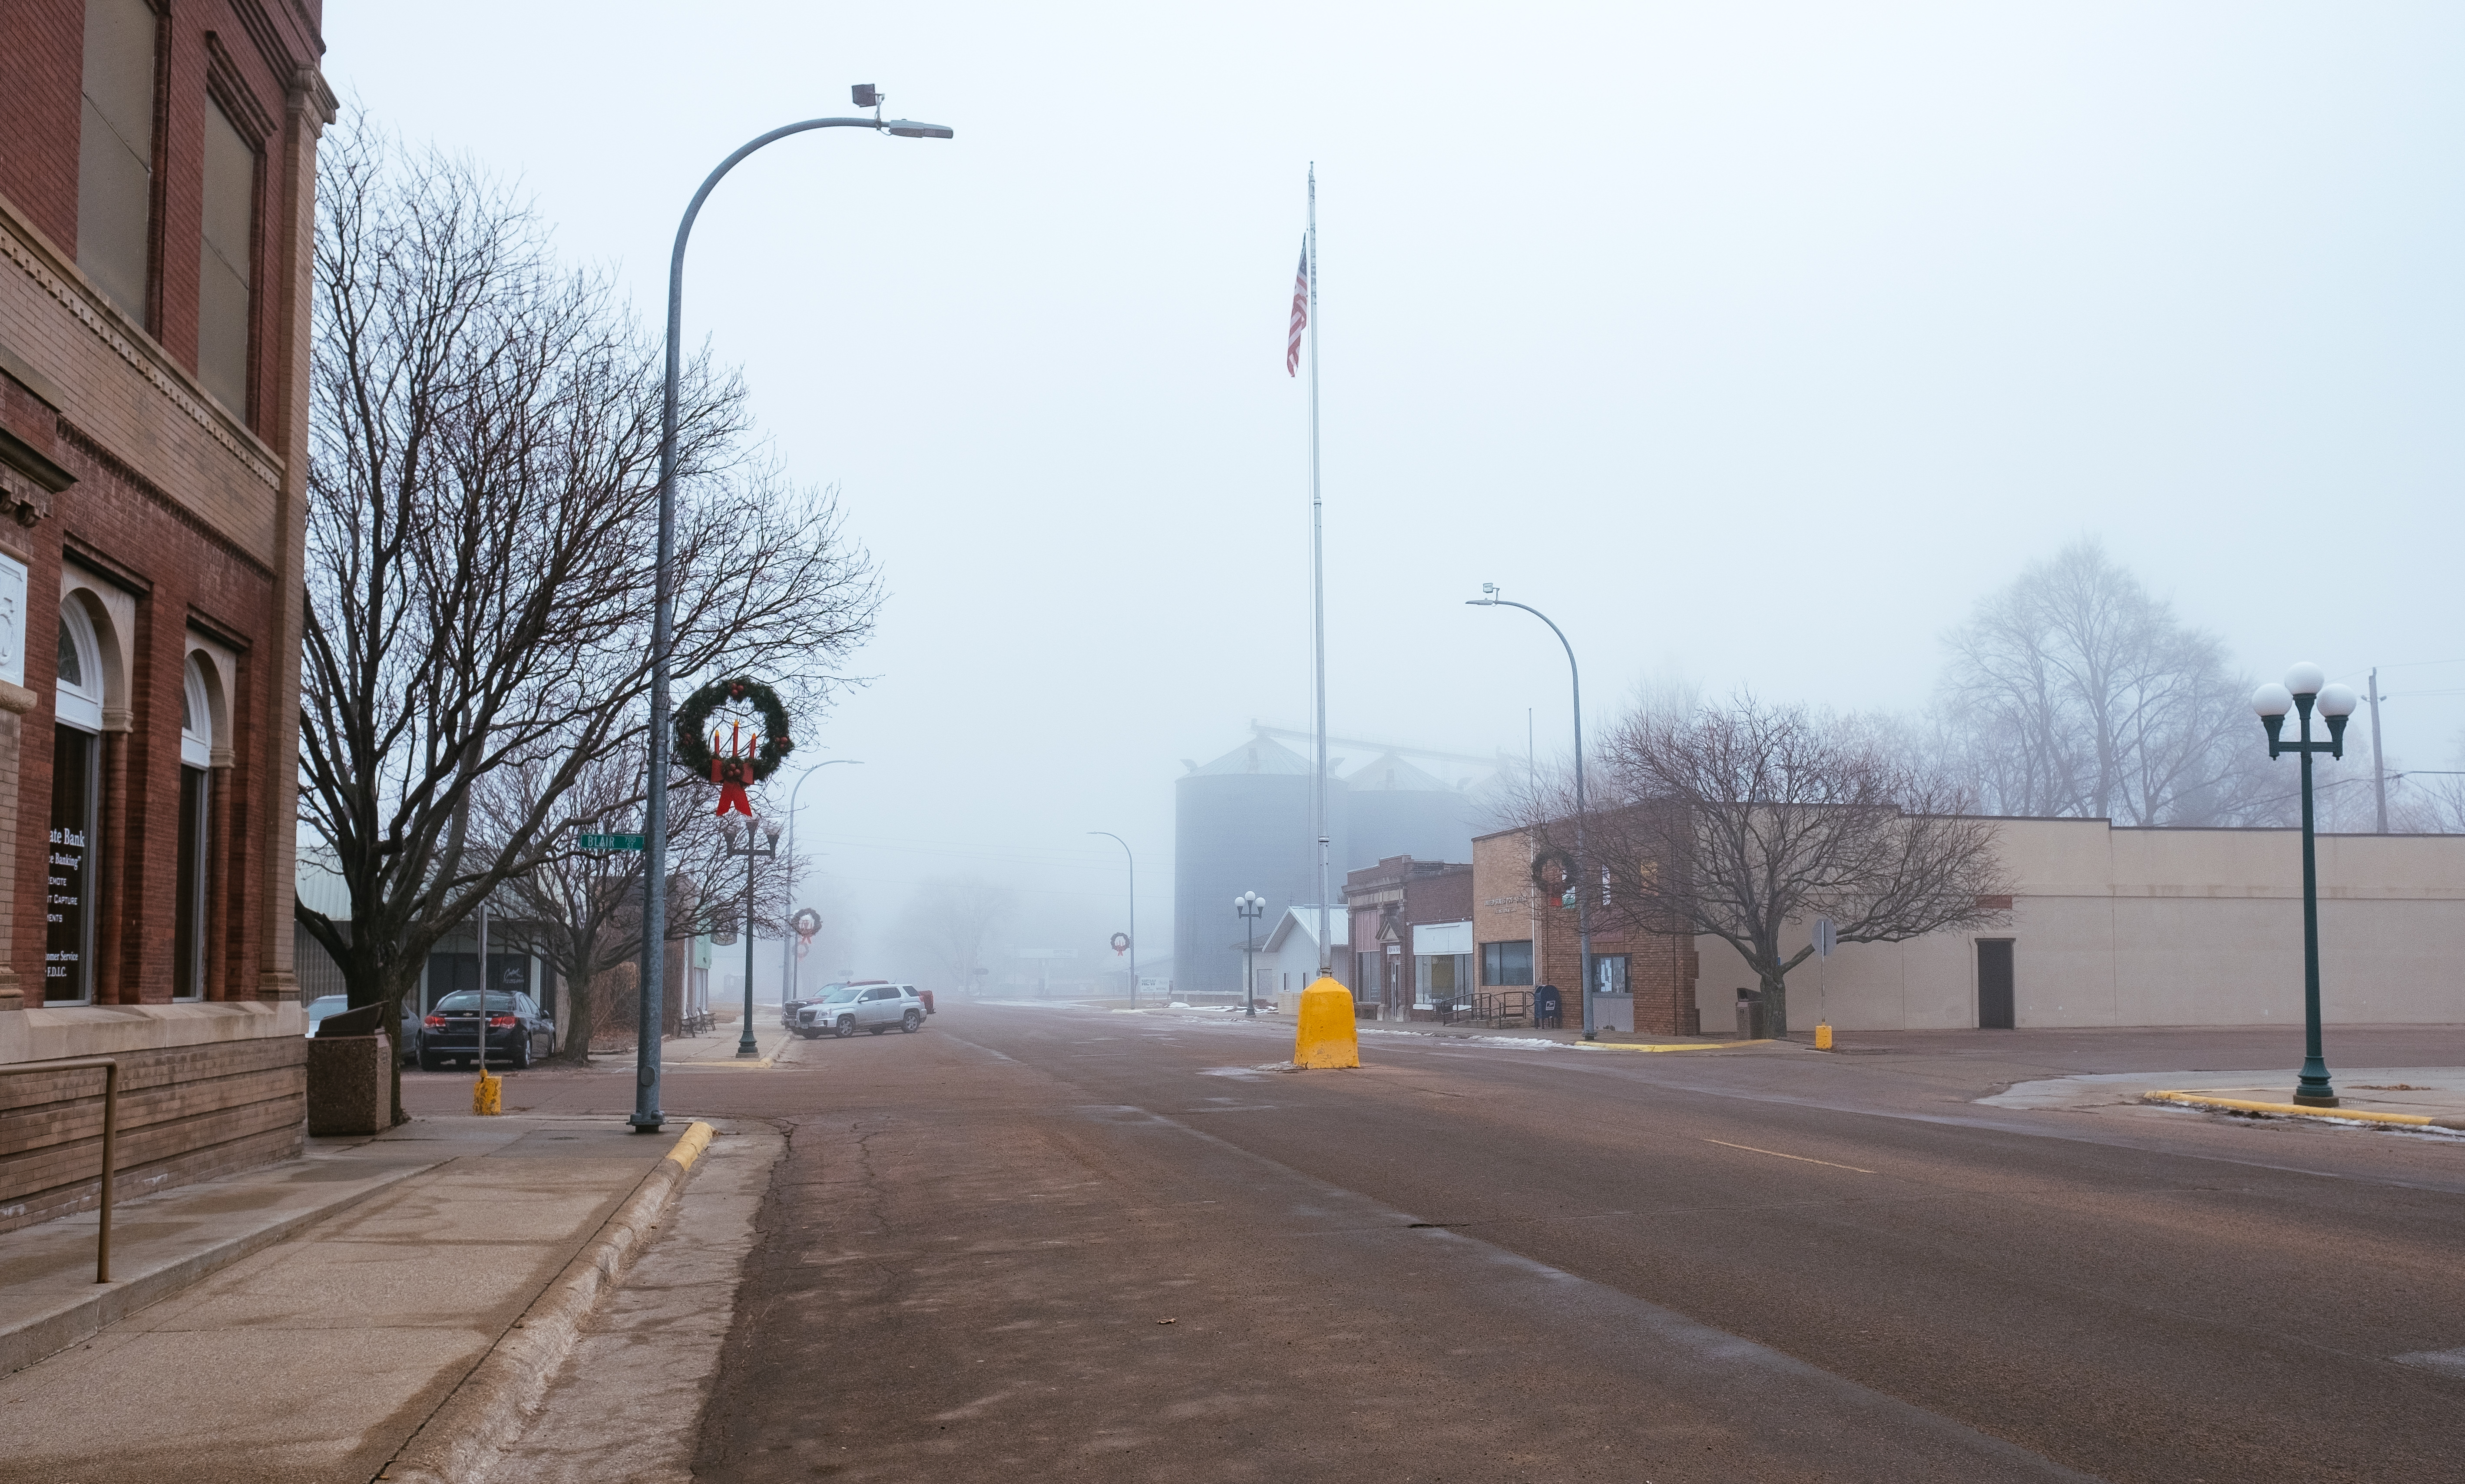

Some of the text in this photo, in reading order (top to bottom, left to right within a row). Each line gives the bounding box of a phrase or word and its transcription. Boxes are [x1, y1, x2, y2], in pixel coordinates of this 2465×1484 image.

[64, 828, 85, 847] Bank
[588, 835, 615, 847] BLAIR
[60, 950, 78, 961] Service
